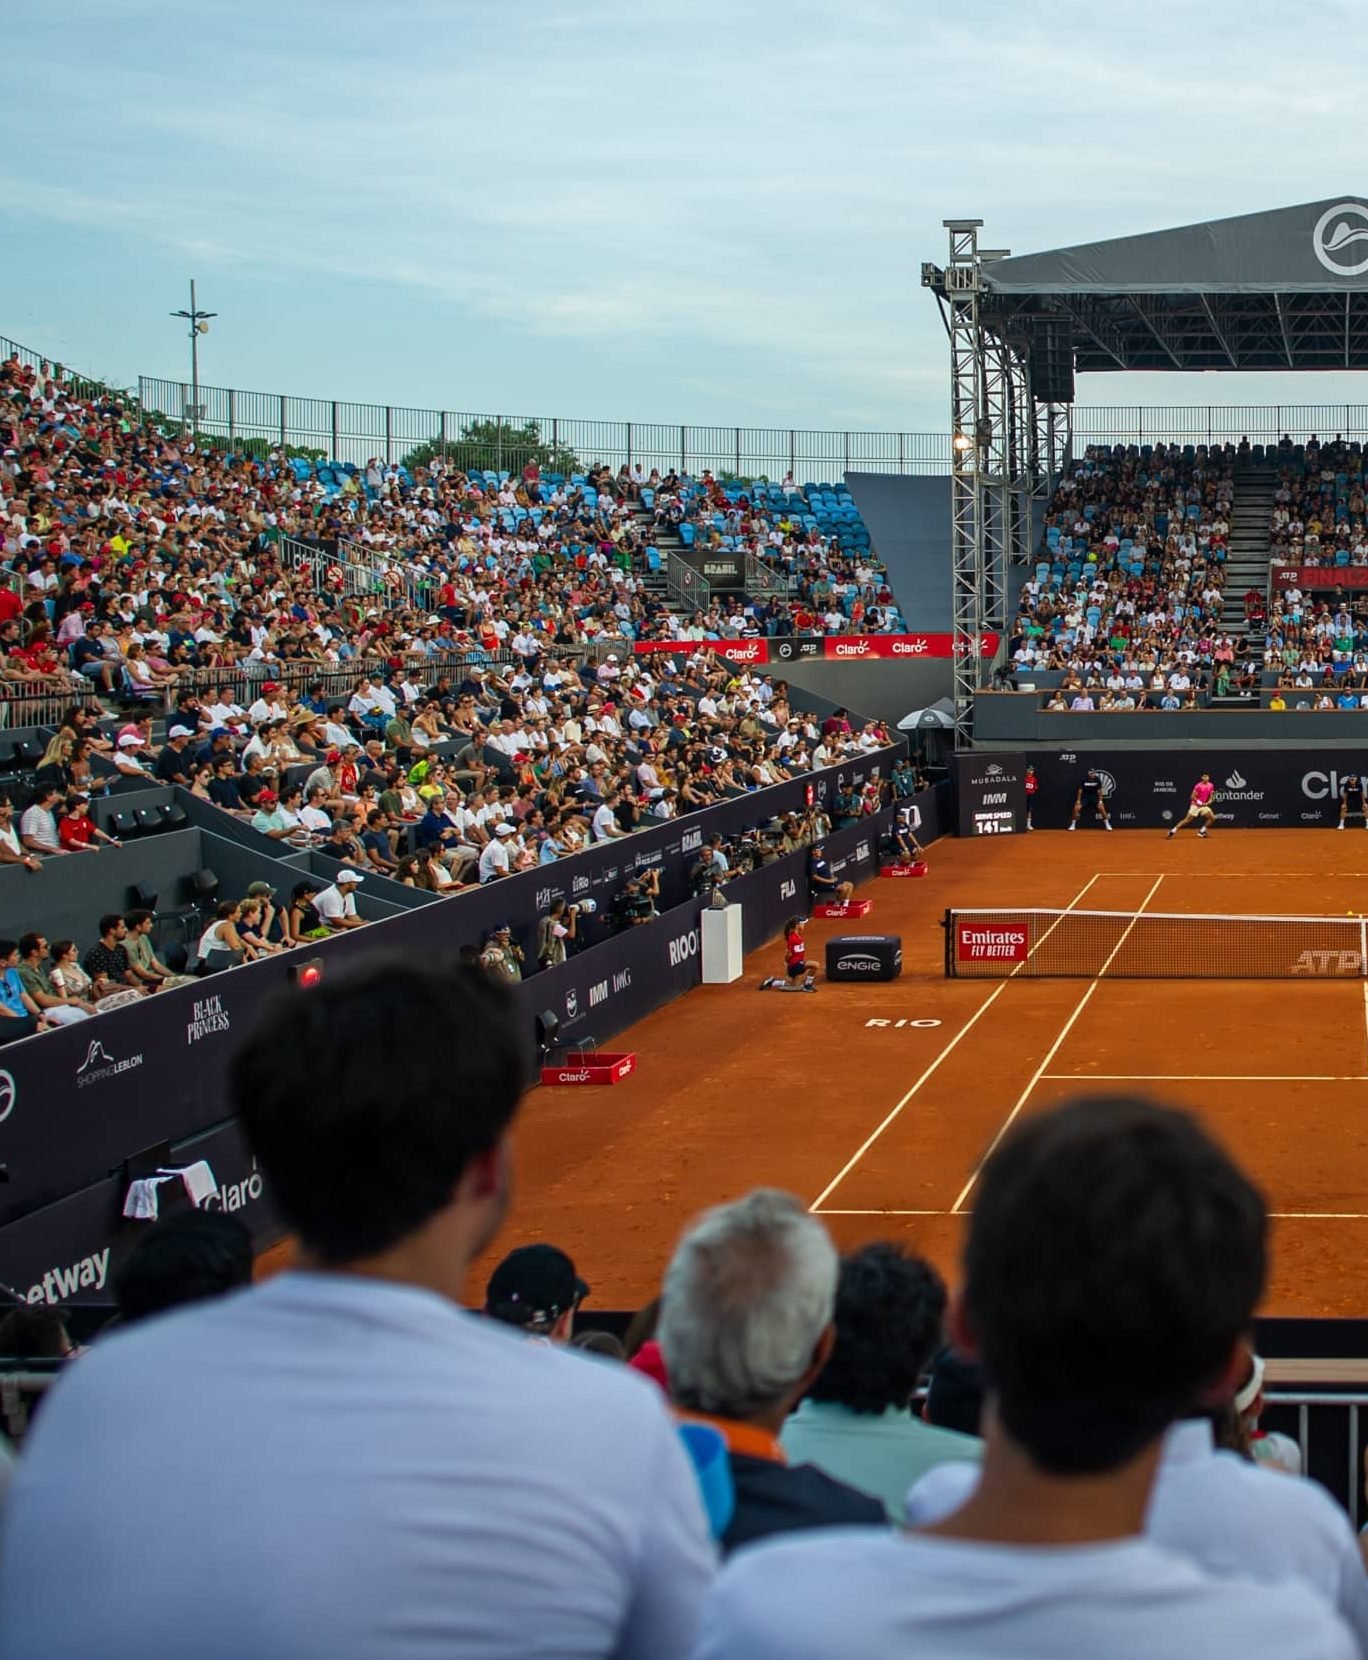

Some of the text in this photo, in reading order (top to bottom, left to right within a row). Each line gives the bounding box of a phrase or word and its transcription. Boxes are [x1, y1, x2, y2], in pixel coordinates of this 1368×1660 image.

[1303, 569, 1357, 586] FINAL
[725, 646, 756, 660] Claro
[836, 642, 867, 655] Claro
[892, 641, 925, 653] Claro
[971, 775, 1018, 785] MUBADALA
[982, 792, 1008, 806] IMM
[1213, 790, 1265, 801] antander
[976, 820, 999, 834] 141
[780, 879, 796, 900] FILA
[961, 929, 1025, 945] Emirates
[668, 930, 699, 966] RIOO
[971, 944, 1016, 957] FLY BETTER
[1290, 950, 1362, 974] ATP
[589, 980, 609, 1008] IMM
[193, 994, 222, 1022] BLACK
[864, 1018, 942, 1028] RIO
[559, 1071, 588, 1082] Claro
[12, 1247, 110, 1305] etway
